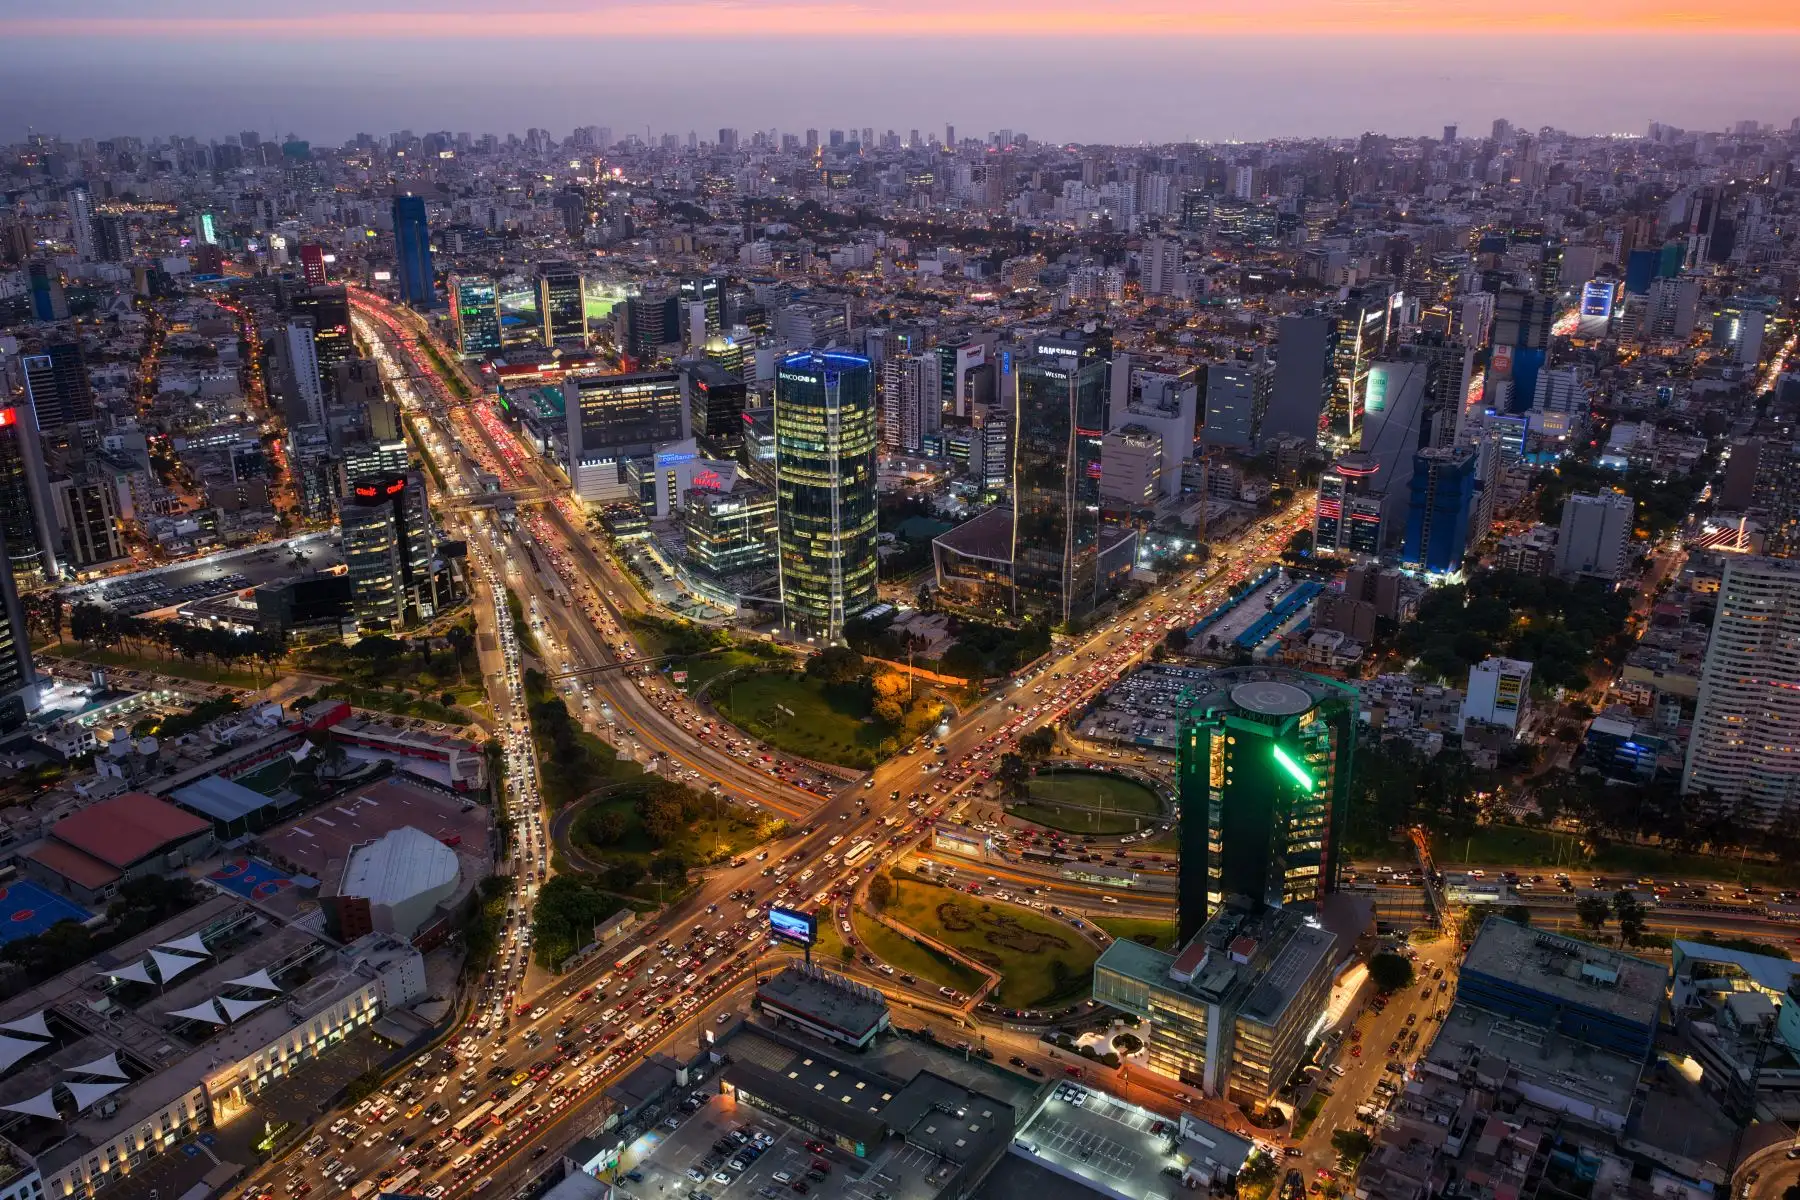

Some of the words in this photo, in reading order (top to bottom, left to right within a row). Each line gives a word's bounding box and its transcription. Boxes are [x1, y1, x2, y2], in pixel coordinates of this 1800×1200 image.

[1038, 345, 1078, 356] SAMSUNG
[779, 371, 797, 381] BANCO
[1045, 370, 1067, 380] WESTIN
[581, 458, 613, 467] RIPLEY
